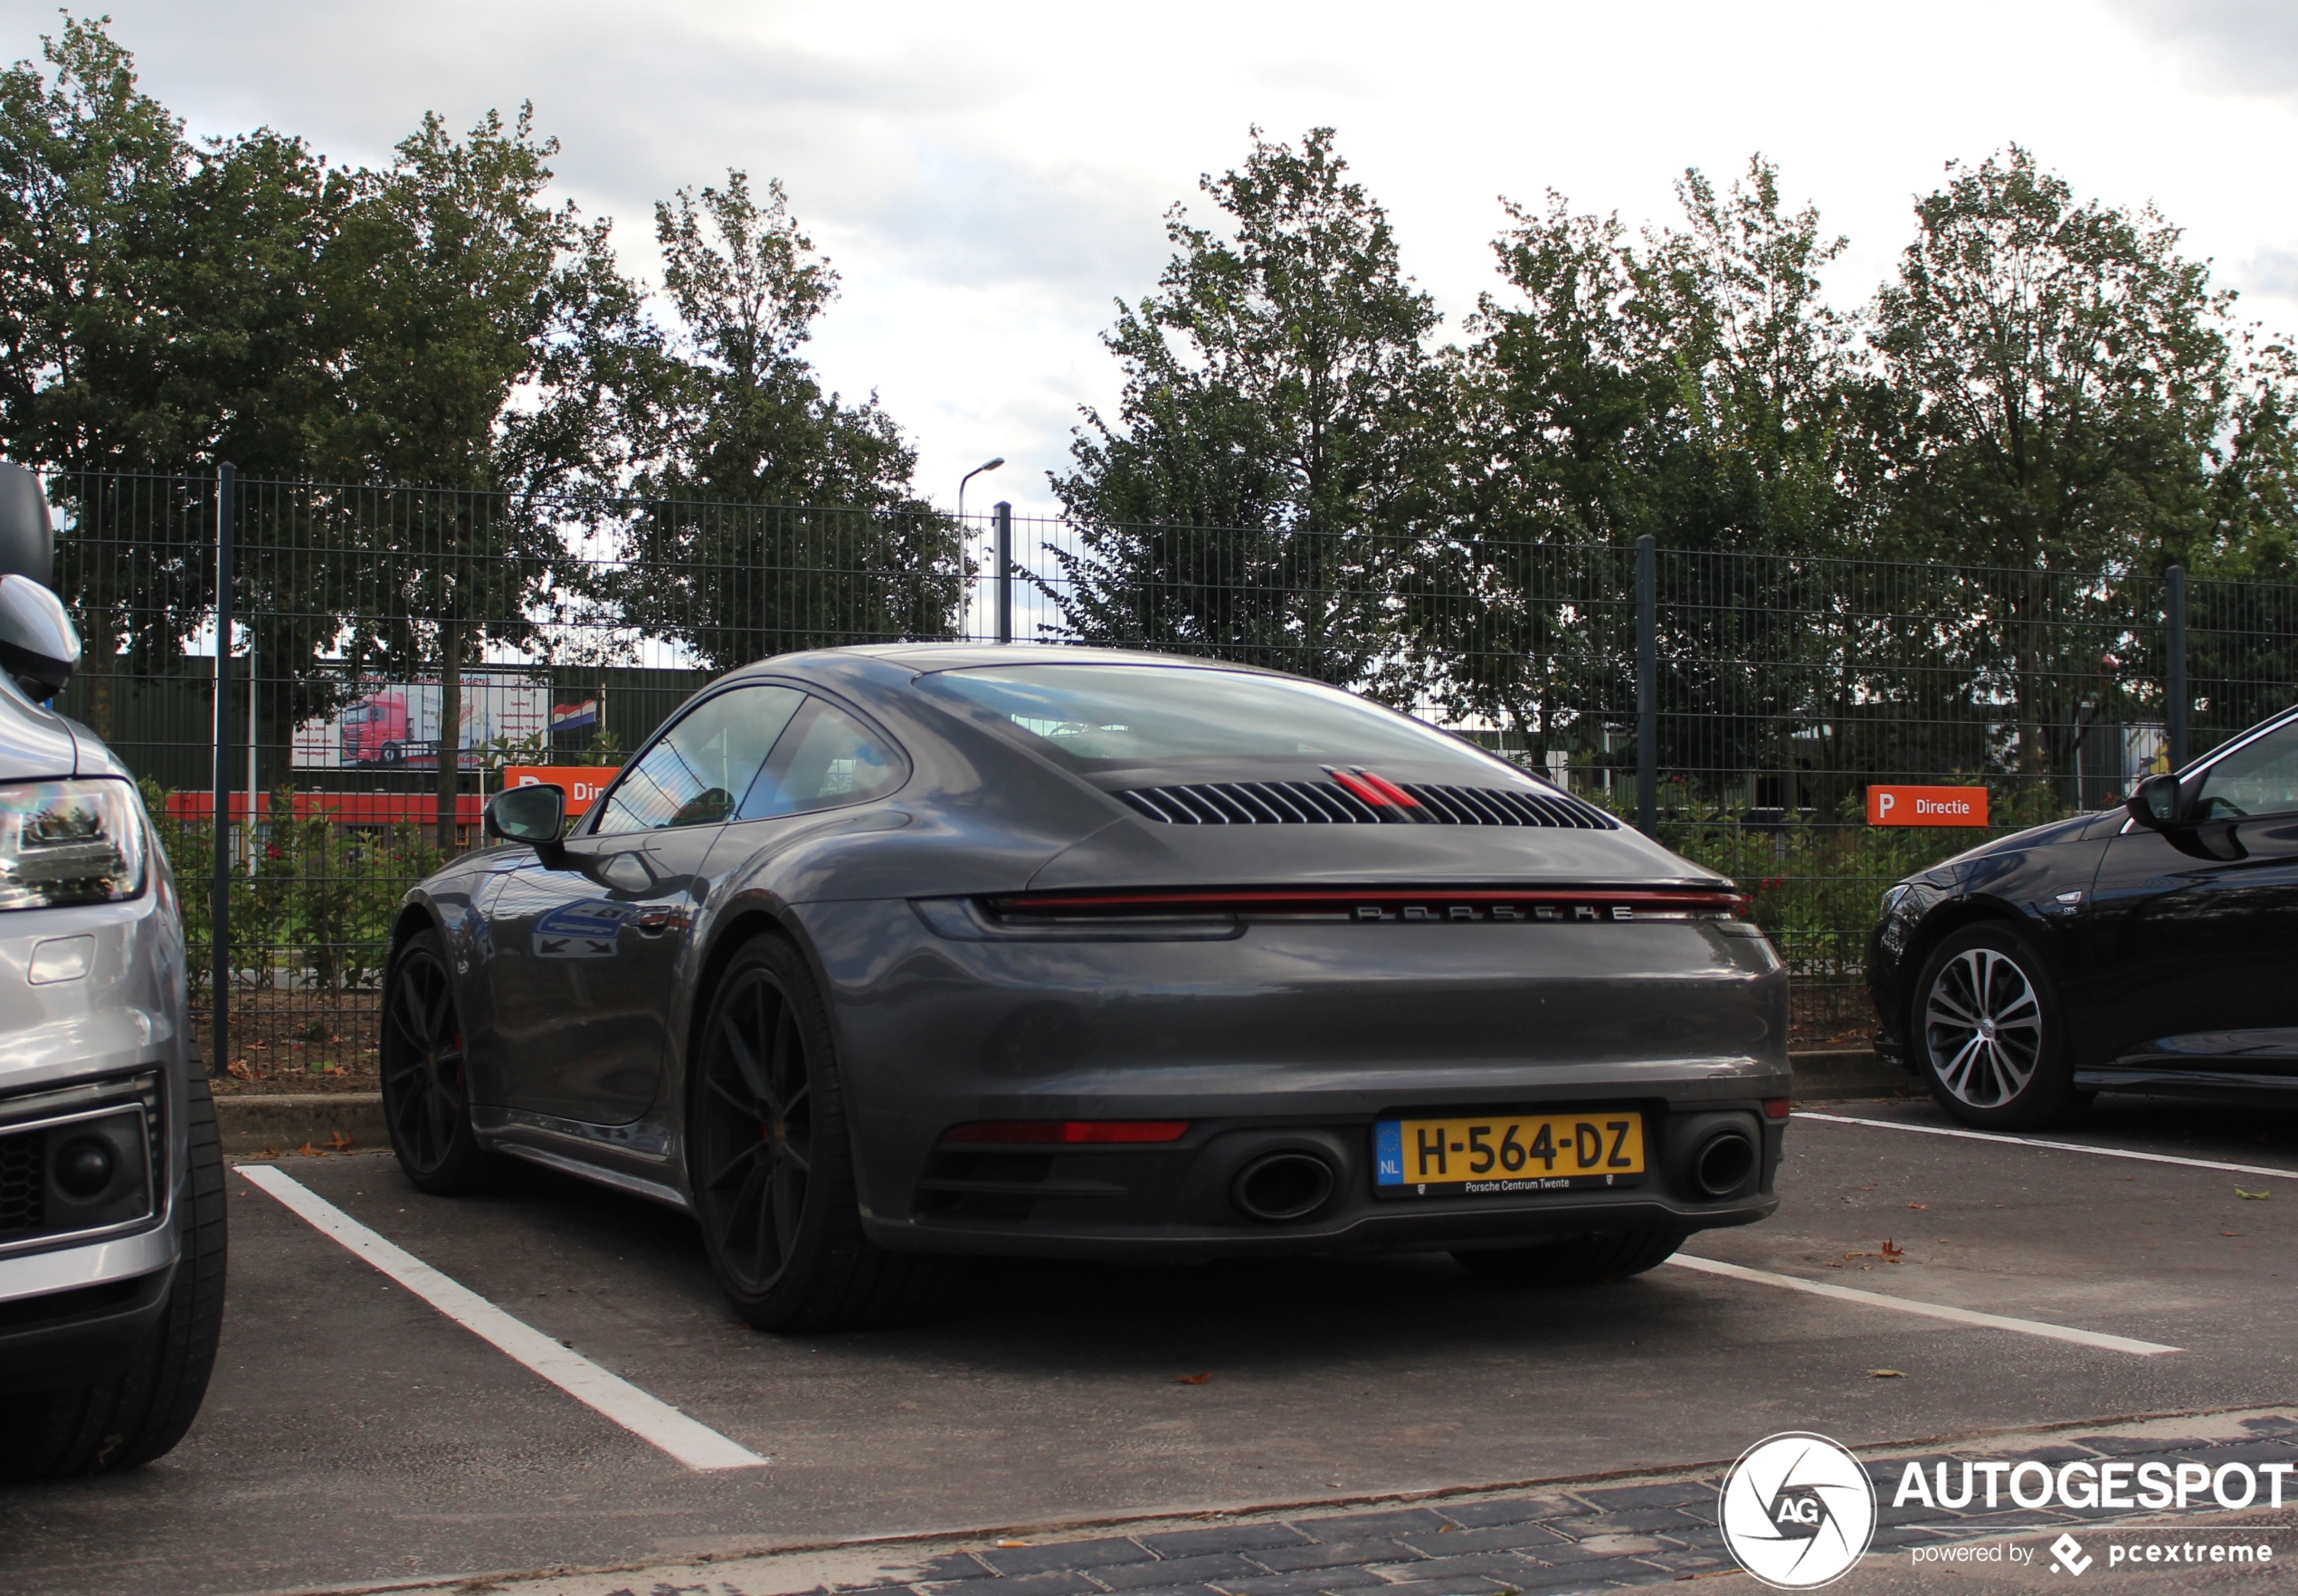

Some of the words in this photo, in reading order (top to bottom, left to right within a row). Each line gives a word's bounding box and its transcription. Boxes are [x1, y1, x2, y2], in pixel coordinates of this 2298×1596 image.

[1879, 793, 1894, 818] P
[1916, 799, 1970, 814] Directie
[1356, 906, 1634, 920] PORSCHE
[1416, 1121, 1631, 1175] H-564-DZ
[1380, 1160, 1400, 1174] NL
[1466, 1182, 1500, 1192] Porsche
[1501, 1180, 1538, 1191] Centrum
[1539, 1178, 1570, 1189] Twente
